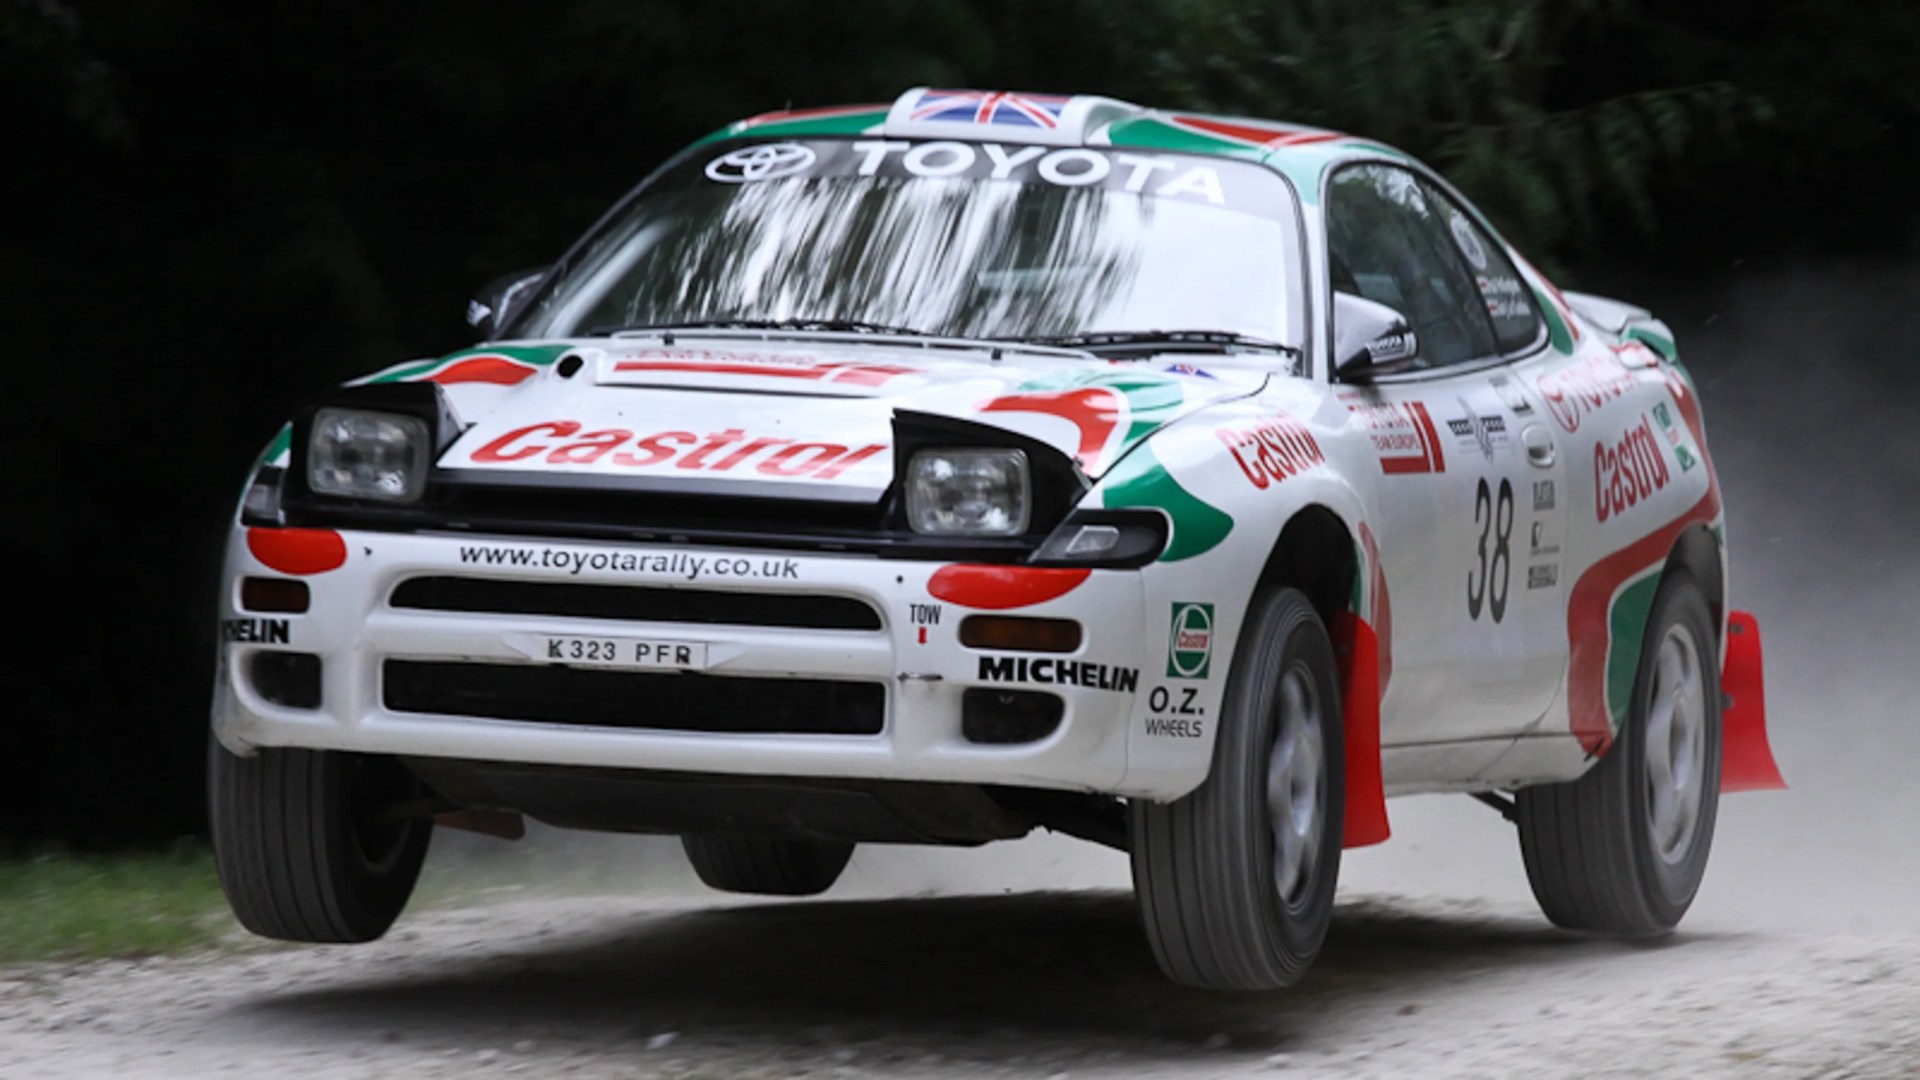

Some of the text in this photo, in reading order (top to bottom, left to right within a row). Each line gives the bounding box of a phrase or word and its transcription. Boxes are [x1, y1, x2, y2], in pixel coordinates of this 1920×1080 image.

[853, 141, 1226, 204] TOYOTA
[470, 420, 888, 480] Castrol
[1214, 412, 1326, 491] Castrol
[1594, 413, 1670, 524] Castrol
[459, 545, 800, 580] www.toyotarally.co.uk
[1467, 476, 1514, 624] 38
[909, 603, 942, 625] TOW
[548, 638, 693, 665] K323 PFR
[978, 656, 1140, 694] MICHELIN
[1148, 685, 1205, 716] O.Z.
[1144, 717, 1204, 738] WHEELS
